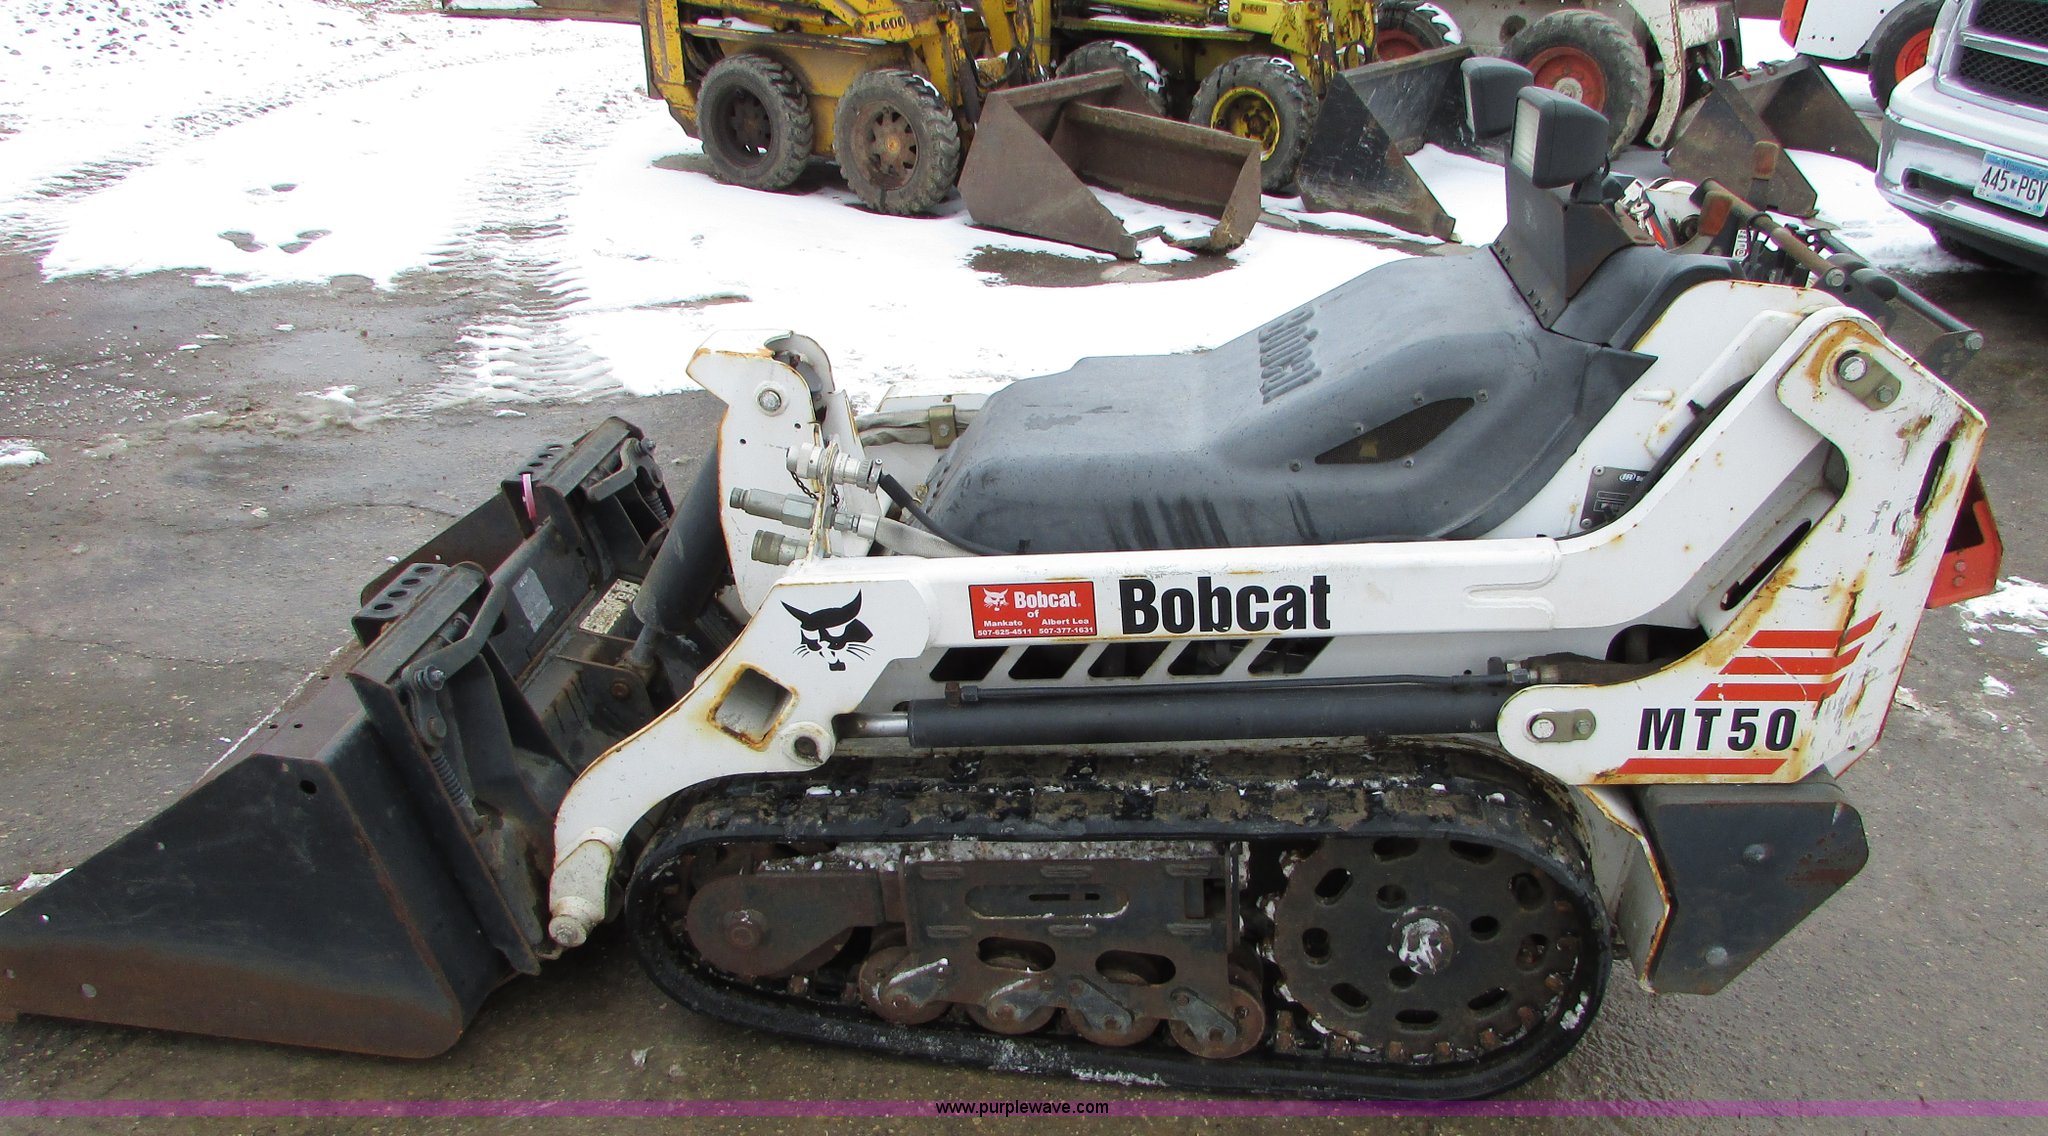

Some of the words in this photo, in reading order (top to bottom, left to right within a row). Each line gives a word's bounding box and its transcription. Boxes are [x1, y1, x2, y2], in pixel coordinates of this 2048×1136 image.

[1981, 166, 2010, 192] 445
[2016, 174, 2048, 203] PGV
[1013, 590, 1077, 609] Bobcat
[1119, 575, 1331, 635] Bobcat
[1027, 609, 1040, 618] of
[1041, 617, 1070, 625] Albert
[977, 628, 1032, 636] 507-625-4511
[1038, 626, 1094, 635] 507-377-1631
[1637, 708, 1797, 751] MT50
